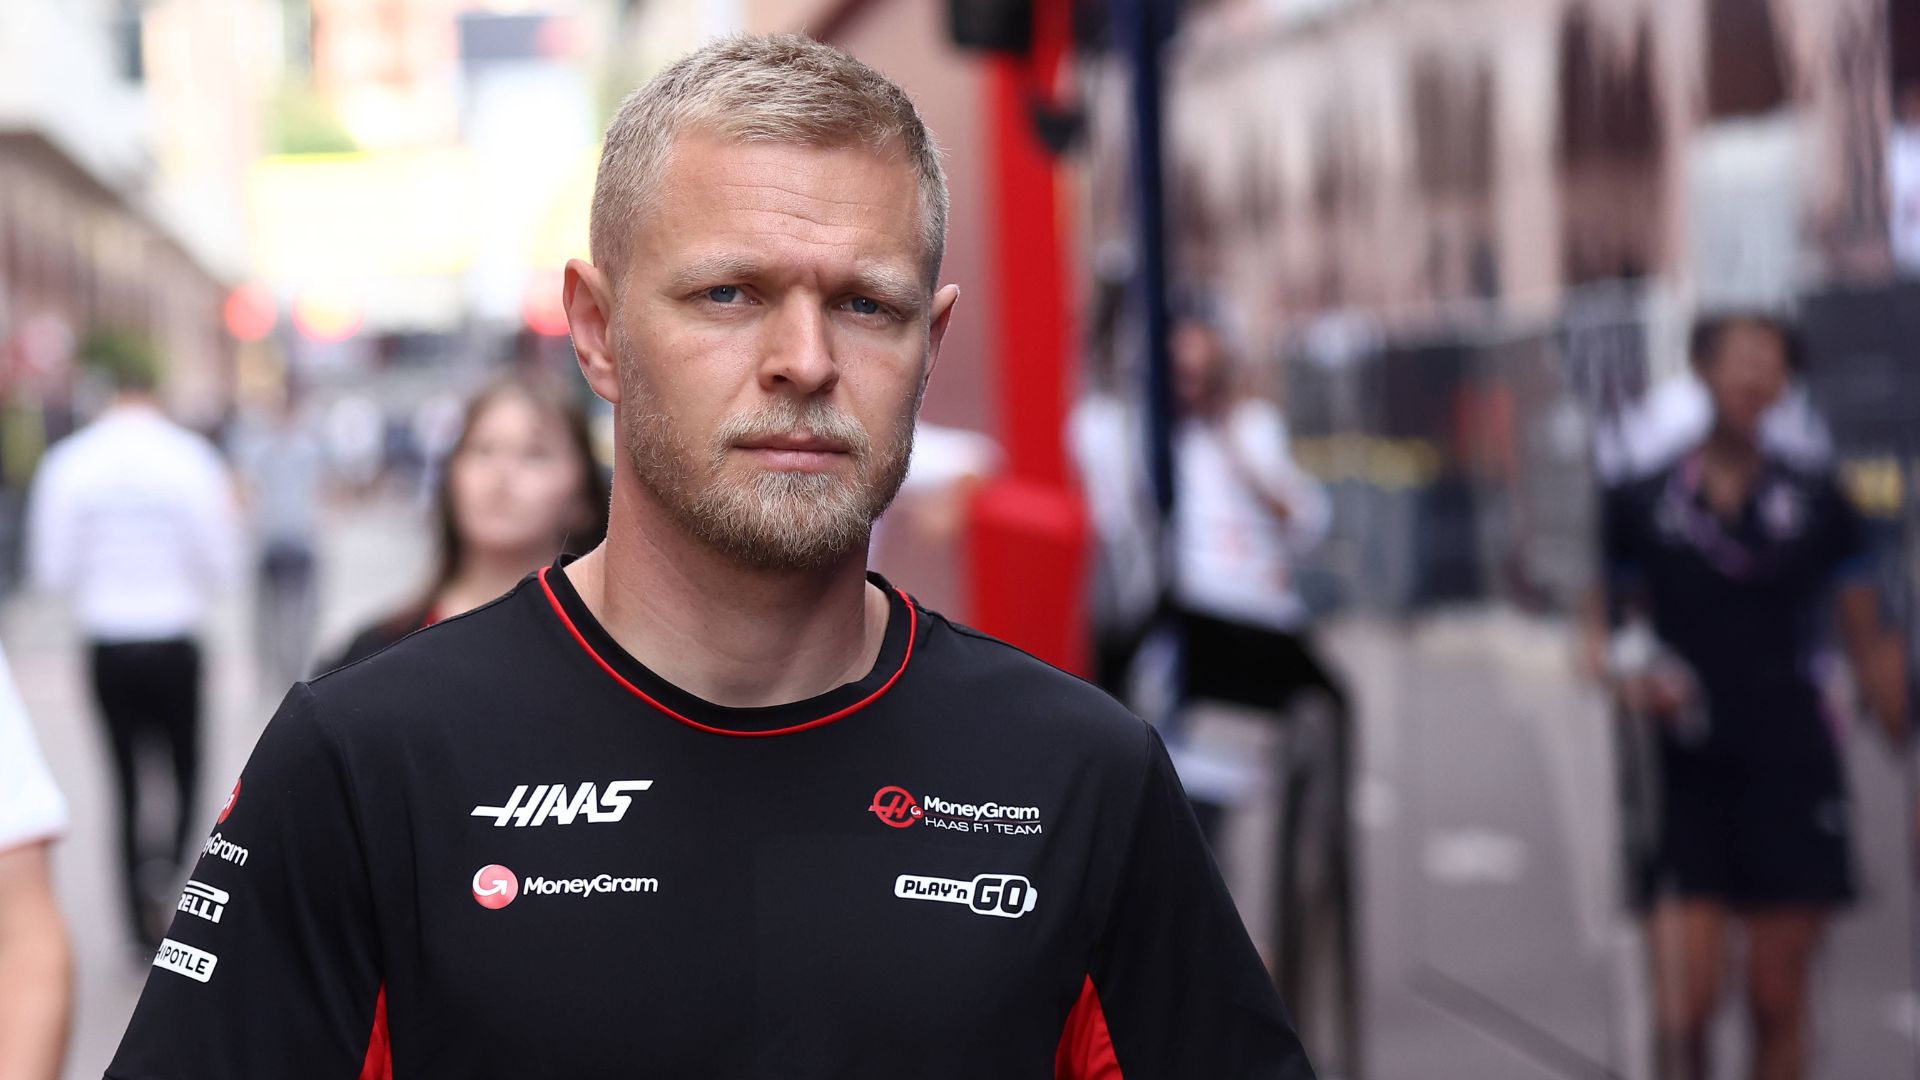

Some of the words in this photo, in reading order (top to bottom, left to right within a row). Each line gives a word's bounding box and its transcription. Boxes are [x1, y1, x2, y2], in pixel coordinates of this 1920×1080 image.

[470, 780, 654, 827] HAAS
[924, 795, 1040, 821] MoneyGram
[925, 817, 969, 832] HAAS
[973, 822, 990, 834] F1
[994, 823, 1042, 835] TEAM
[523, 873, 659, 898] MoneyGram
[903, 879, 968, 900] PLAY'n
[972, 877, 1028, 914] GO
